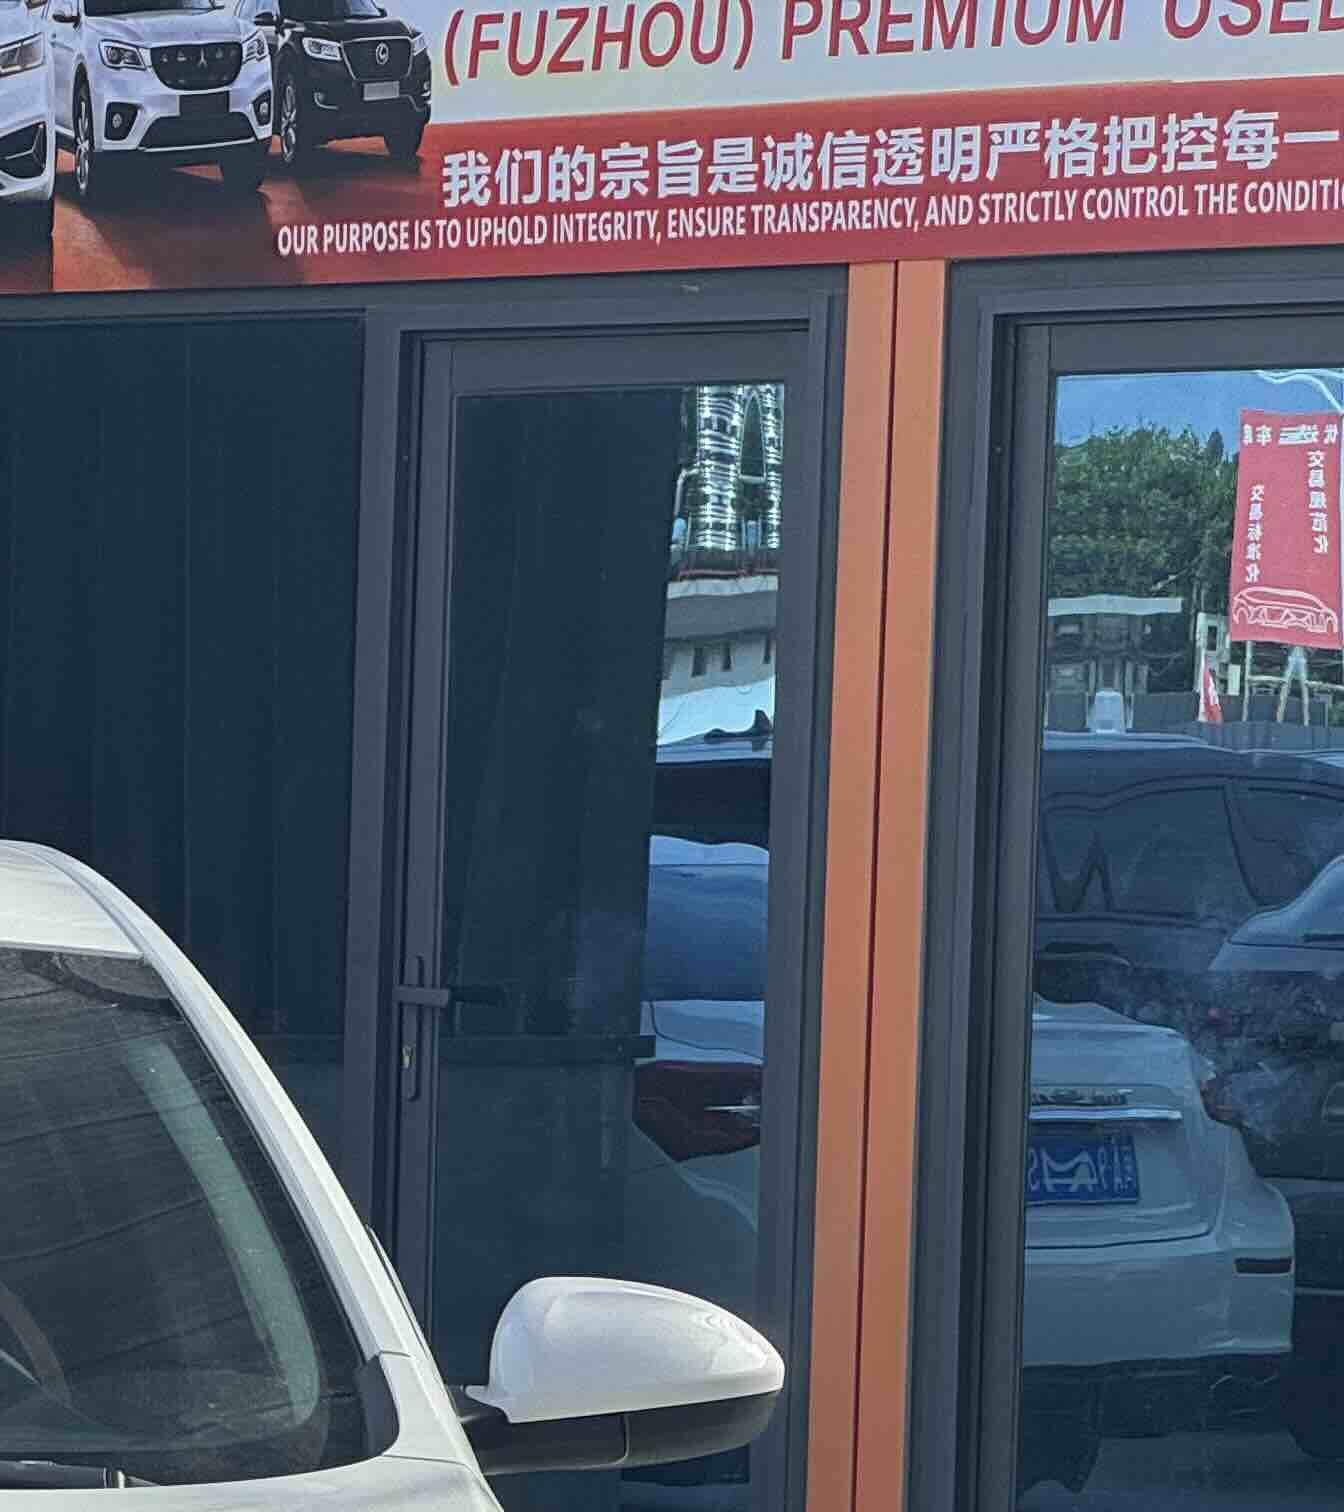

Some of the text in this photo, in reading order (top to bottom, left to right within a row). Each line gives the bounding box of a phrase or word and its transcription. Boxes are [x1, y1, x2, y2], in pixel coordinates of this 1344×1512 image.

[443, 0, 753, 86] (FUZHOU)
[781, 0, 1123, 60] PREMIUM
[441, 109, 1340, 208] 我们的宗旨是诚信透明严格把控每一
[277, 177, 1344, 256] OUR PURPOSE IS TO UPHOLD INTEGRITY, ENSURE TRANSPARENCY, AND STRICTLY CONTROL THE CONDITI
